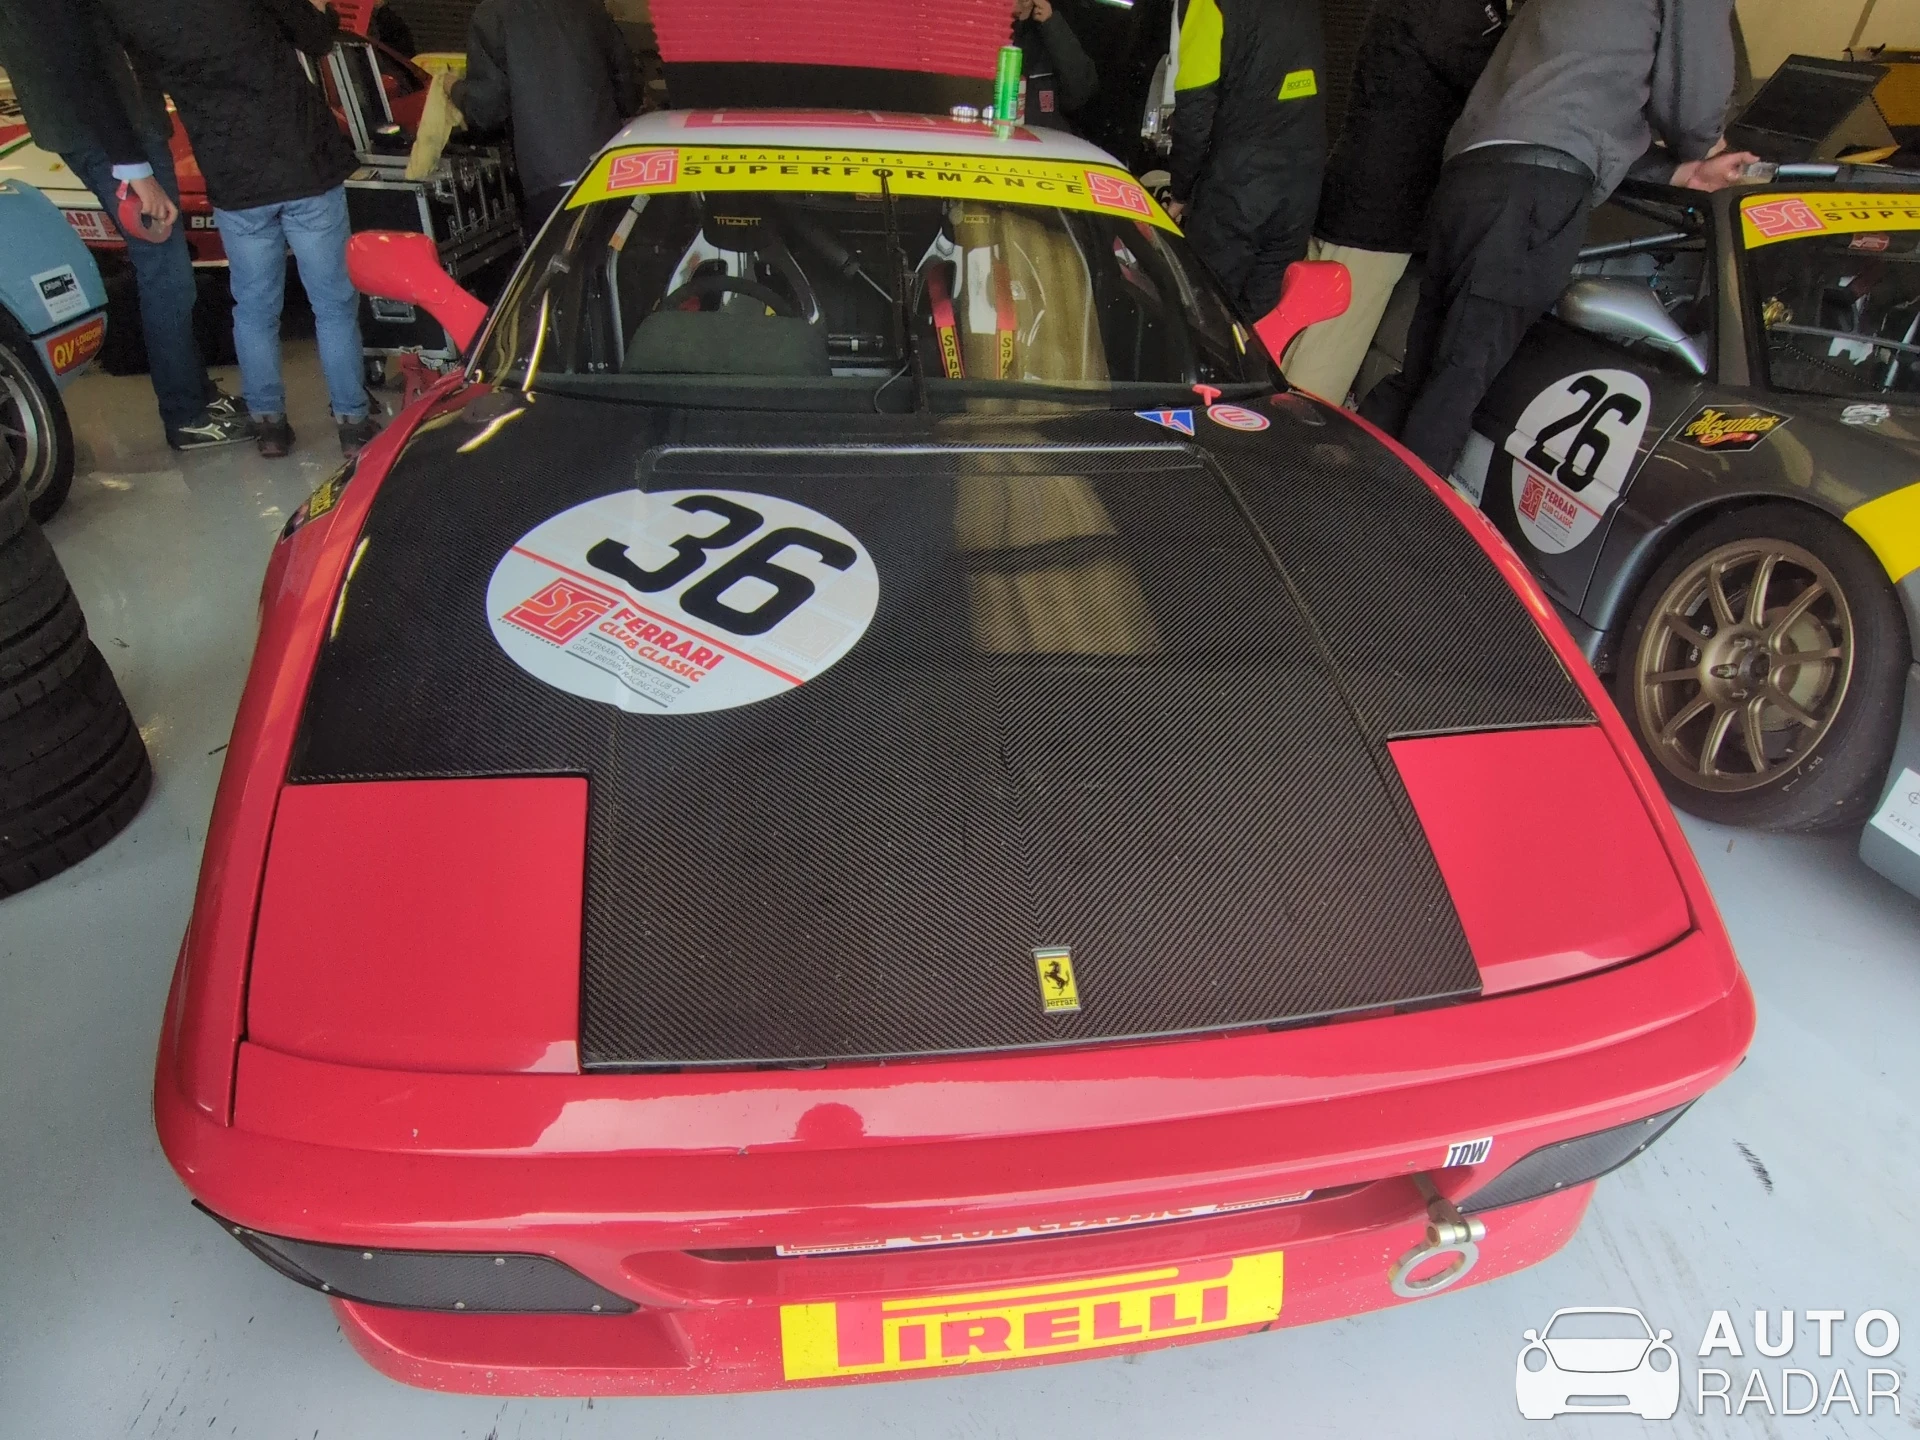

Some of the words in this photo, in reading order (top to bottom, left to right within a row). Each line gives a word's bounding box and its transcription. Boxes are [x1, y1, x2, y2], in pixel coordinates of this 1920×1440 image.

[607, 149, 679, 191] SF
[683, 165, 1085, 195] SUPERFORMANCE
[686, 154, 800, 162] FERRARI
[824, 155, 904, 165] PARTS
[927, 160, 1080, 181] SPECIALIST
[1083, 169, 1154, 218] SF
[1743, 198, 1828, 239] SF
[1525, 375, 1642, 493] 26
[1544, 487, 1578, 520] FERRARI
[586, 495, 857, 637] 36
[497, 617, 561, 649] SUPERFORMANCE
[502, 577, 620, 646] SF
[598, 621, 640, 651] CLUB
[638, 645, 707, 683] CLASSIC
[611, 607, 725, 671] FERRARI
[572, 643, 596, 658] GREAT
[595, 651, 623, 674] BRITAIN
[622, 670, 651, 692] RACING
[649, 685, 678, 704] SERIES
[587, 638, 617, 656] FERRARI
[651, 672, 672, 689] CLUB
[671, 685, 686, 696] OF
[1046, 997, 1078, 1007] Ferrari
[1447, 1139, 1490, 1167] TOW
[835, 1254, 1233, 1367] PIRELLI
